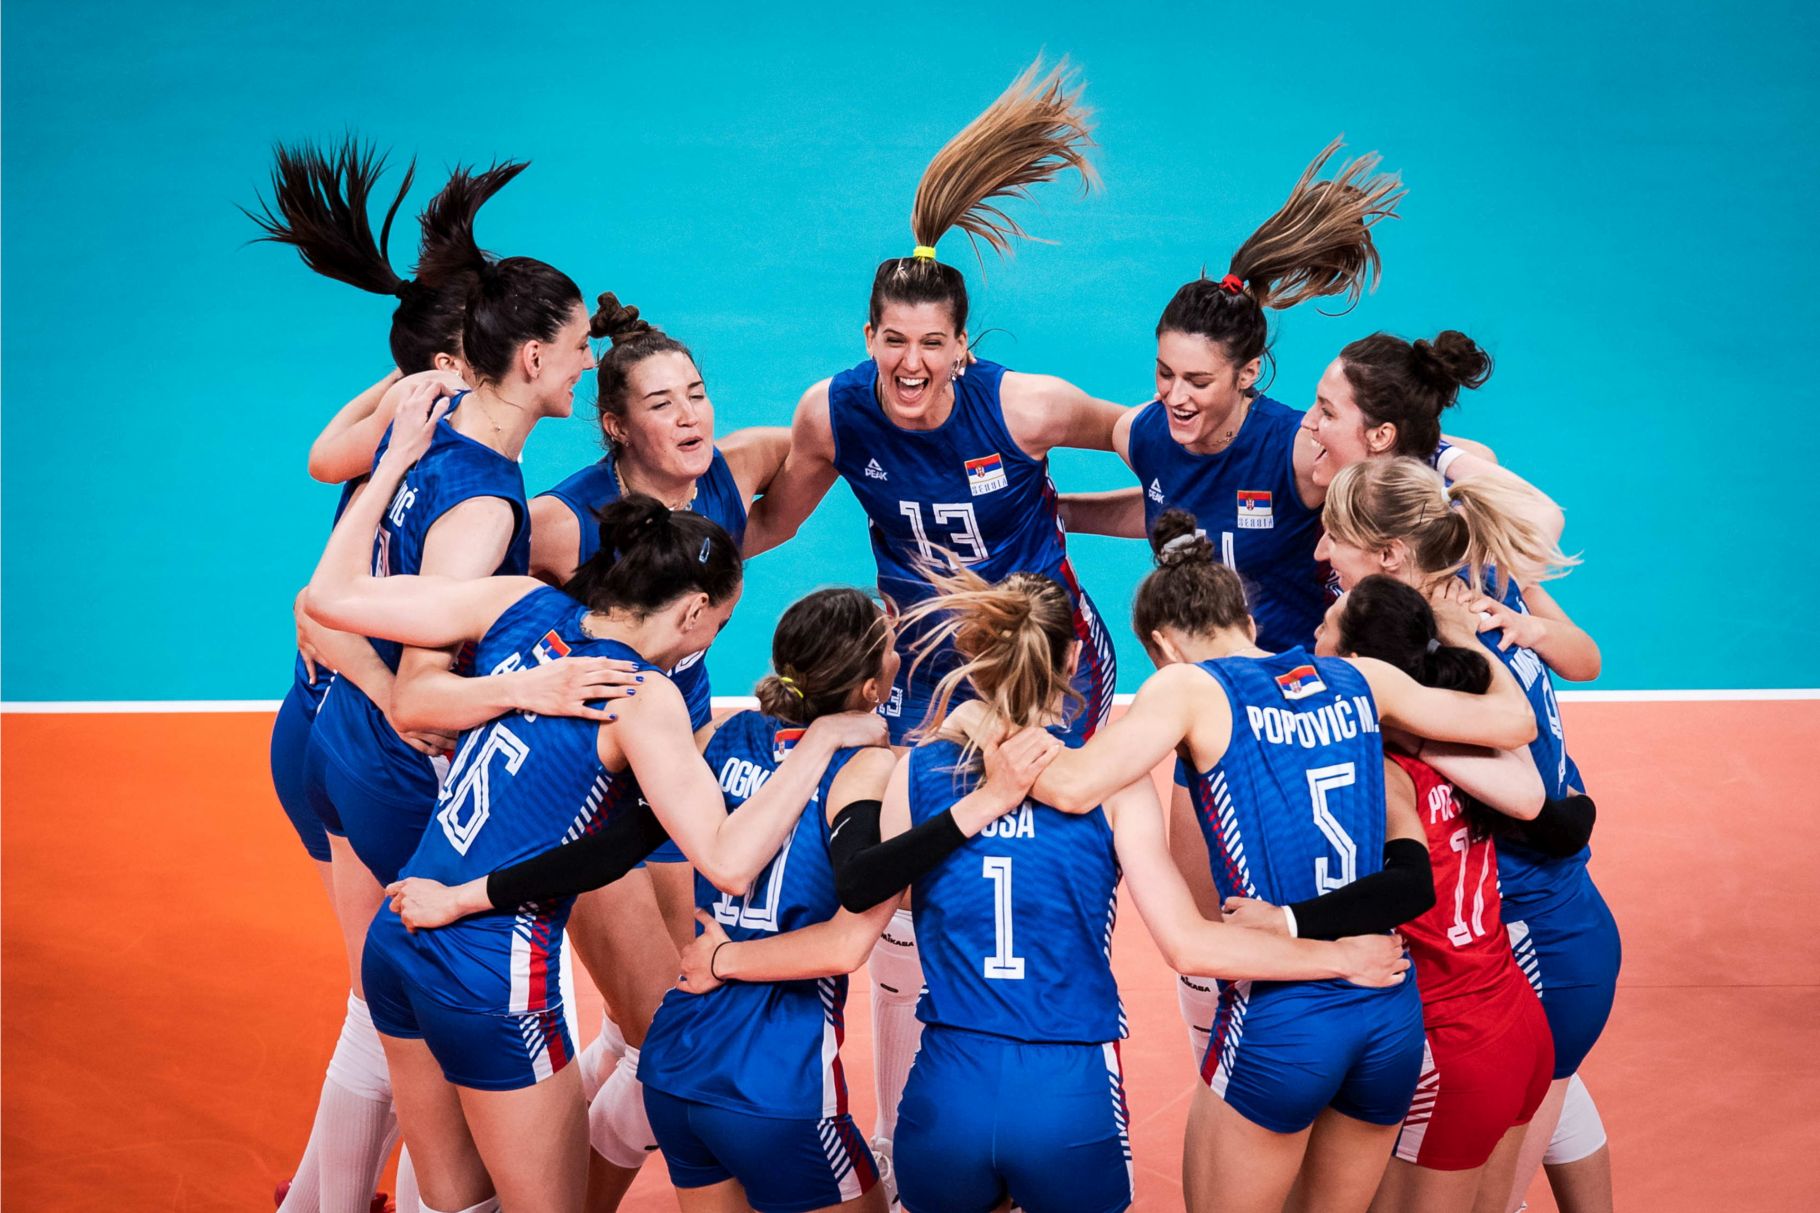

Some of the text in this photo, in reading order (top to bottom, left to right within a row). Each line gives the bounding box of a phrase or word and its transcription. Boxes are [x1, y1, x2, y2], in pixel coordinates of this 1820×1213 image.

[864, 467, 888, 481] PEAK
[1148, 489, 1164, 504] PEAK
[389, 480, 419, 528] IĆ
[899, 500, 990, 570] 13
[1246, 695, 1380, 749] POPOVIĆ M.
[719, 757, 773, 799] OGN
[1305, 761, 1357, 897] 5
[983, 856, 1025, 980] 1
